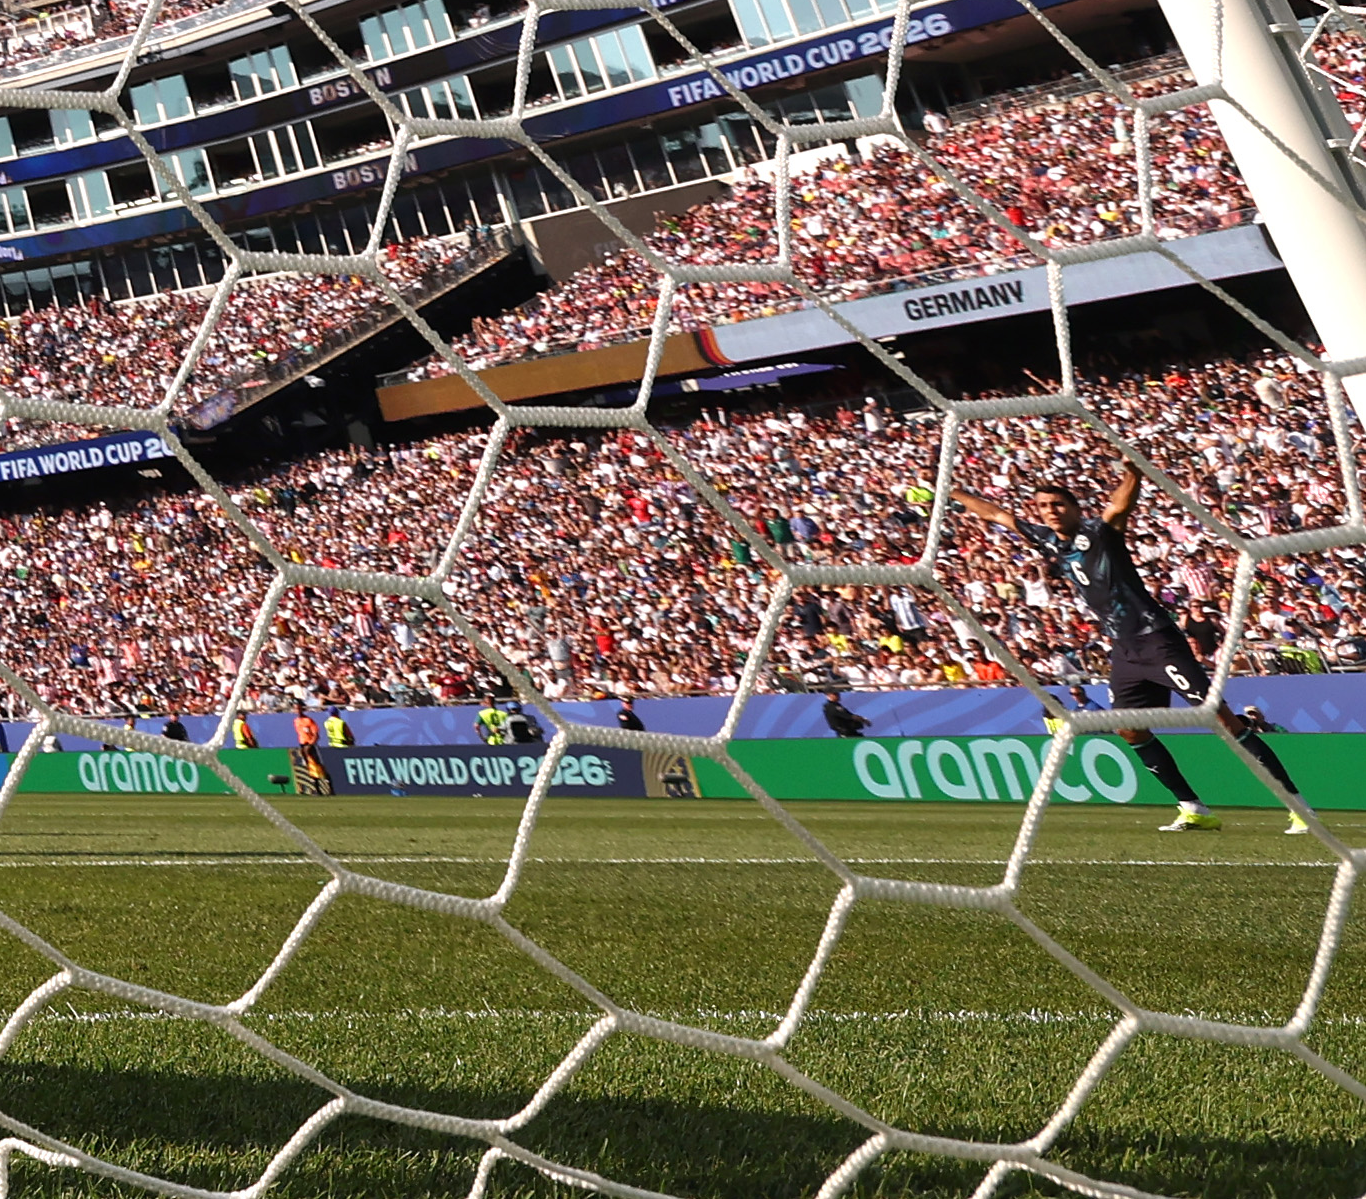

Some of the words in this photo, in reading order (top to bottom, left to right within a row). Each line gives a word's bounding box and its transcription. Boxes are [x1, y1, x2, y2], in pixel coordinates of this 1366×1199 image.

[309, 67, 392, 106] BOSTN
[668, 75, 719, 108] FIFA
[725, 54, 806, 90] WORLD
[805, 38, 856, 70] CUP
[332, 152, 419, 190] BOSTN
[904, 279, 1026, 322] GERMANY
[0, 458, 41, 481] FIFA
[38, 447, 104, 476] WORLD
[106, 440, 144, 466] CUP
[1071, 560, 1090, 586] 6
[1165, 664, 1190, 691] 6
[78, 751, 200, 794] aramco
[343, 757, 389, 786] FIFA
[391, 756, 468, 787] WORLD
[469, 756, 516, 786] CUP
[853, 737, 1138, 804] aramco
